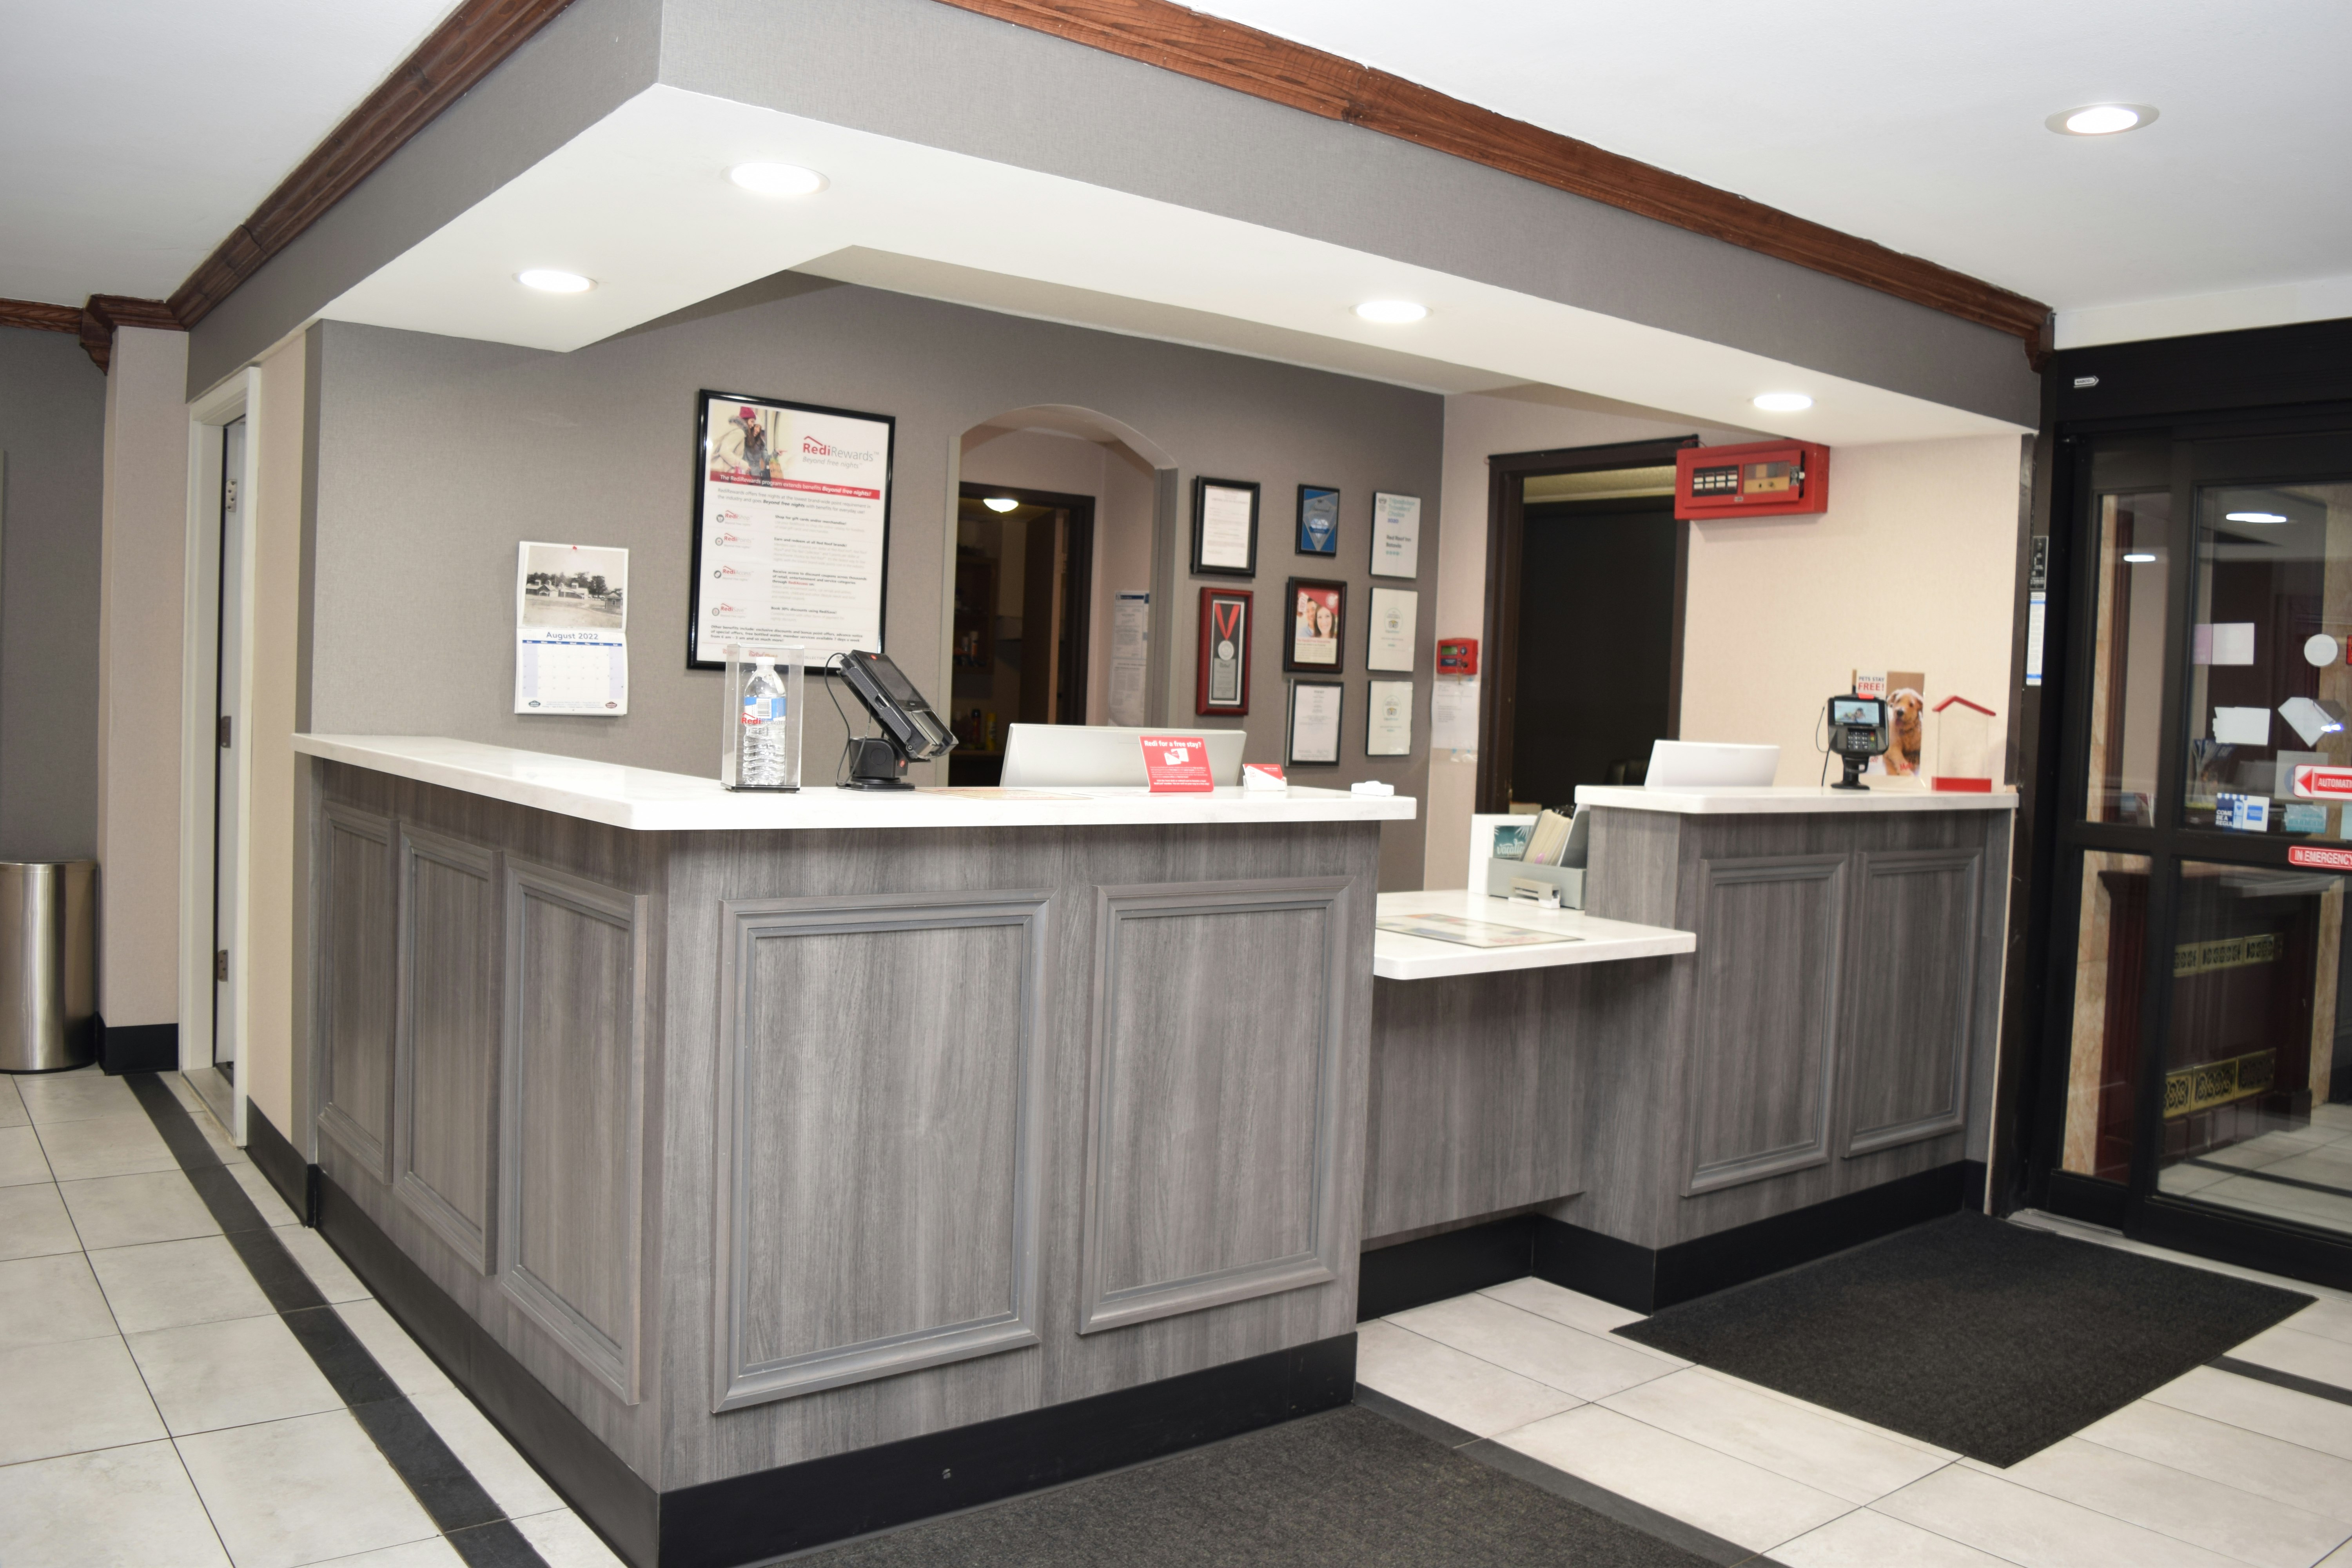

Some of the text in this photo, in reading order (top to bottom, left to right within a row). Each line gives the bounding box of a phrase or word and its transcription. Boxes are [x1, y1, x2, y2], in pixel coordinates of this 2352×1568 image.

[802, 456, 825, 465] Beyond
[546, 632, 575, 640] August
[1858, 682, 1884, 691] FREE!
[741, 717, 786, 725] RediRewar
[2318, 778, 2352, 788] AUTOMATI
[2294, 849, 2352, 866] IN EMERGENCY
